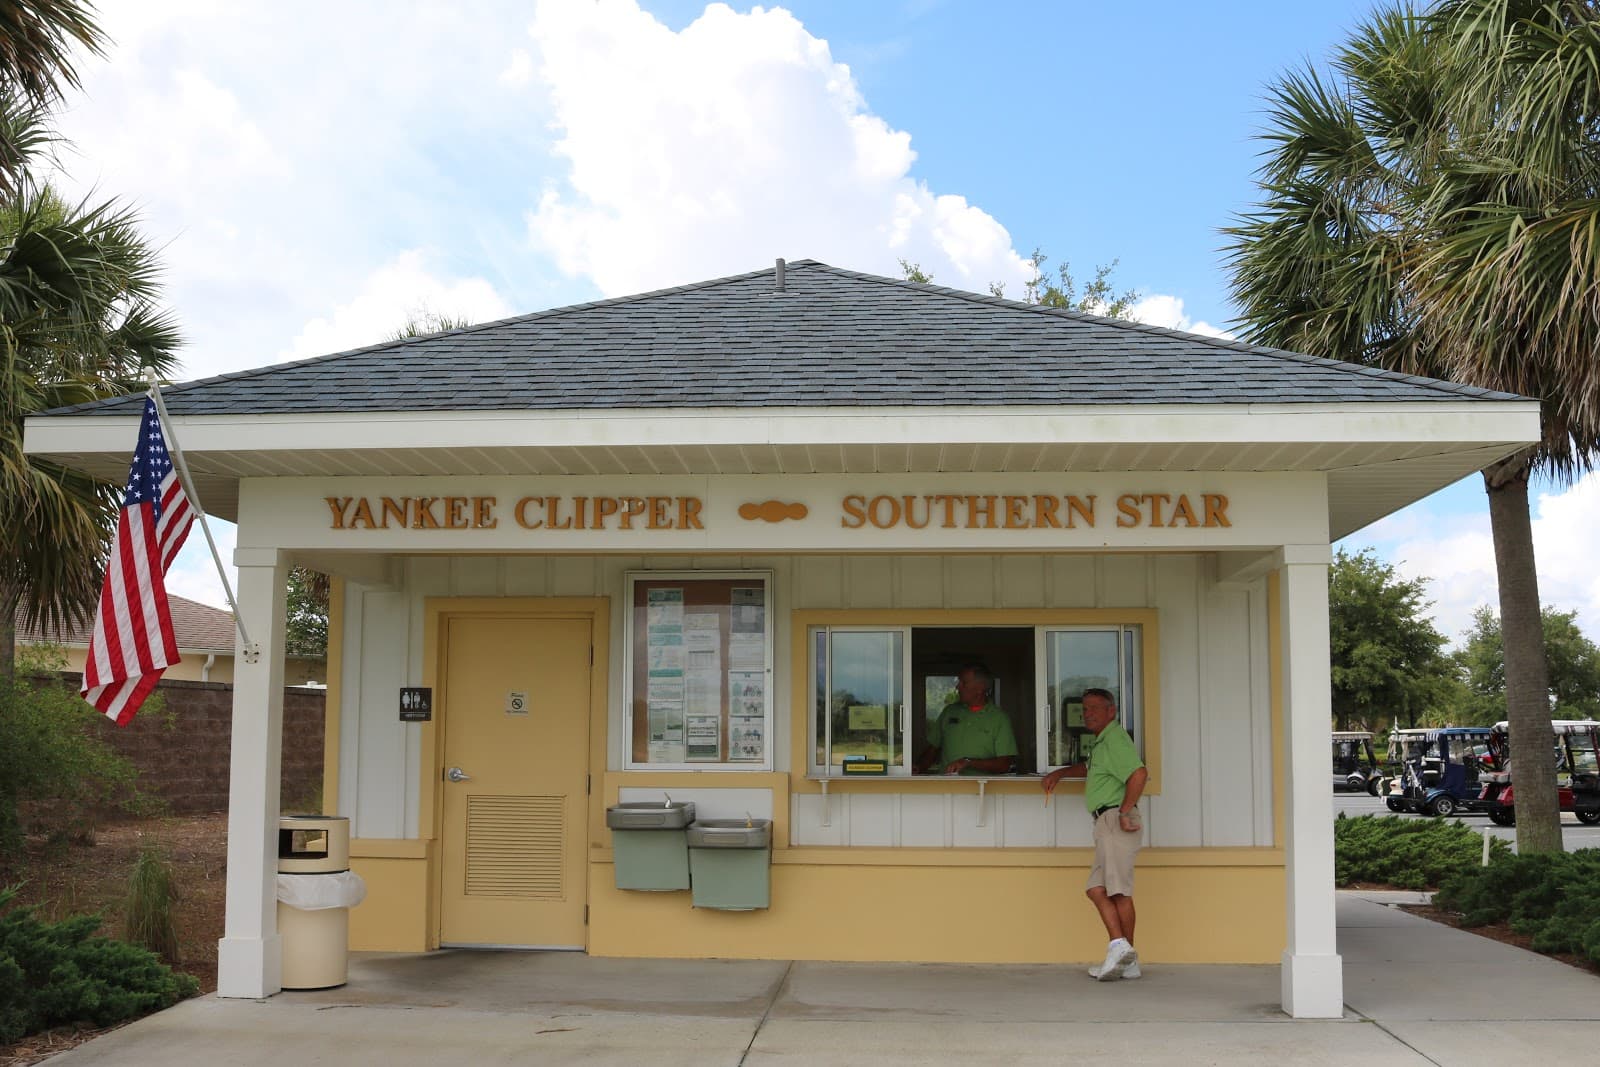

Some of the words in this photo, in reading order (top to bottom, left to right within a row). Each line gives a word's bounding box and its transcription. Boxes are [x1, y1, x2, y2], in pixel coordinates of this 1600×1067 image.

[325, 496, 498, 529] YANKEE
[515, 496, 705, 529] CLIPPER
[842, 495, 1097, 529] SOUTHERN
[1117, 493, 1232, 528] STAR
